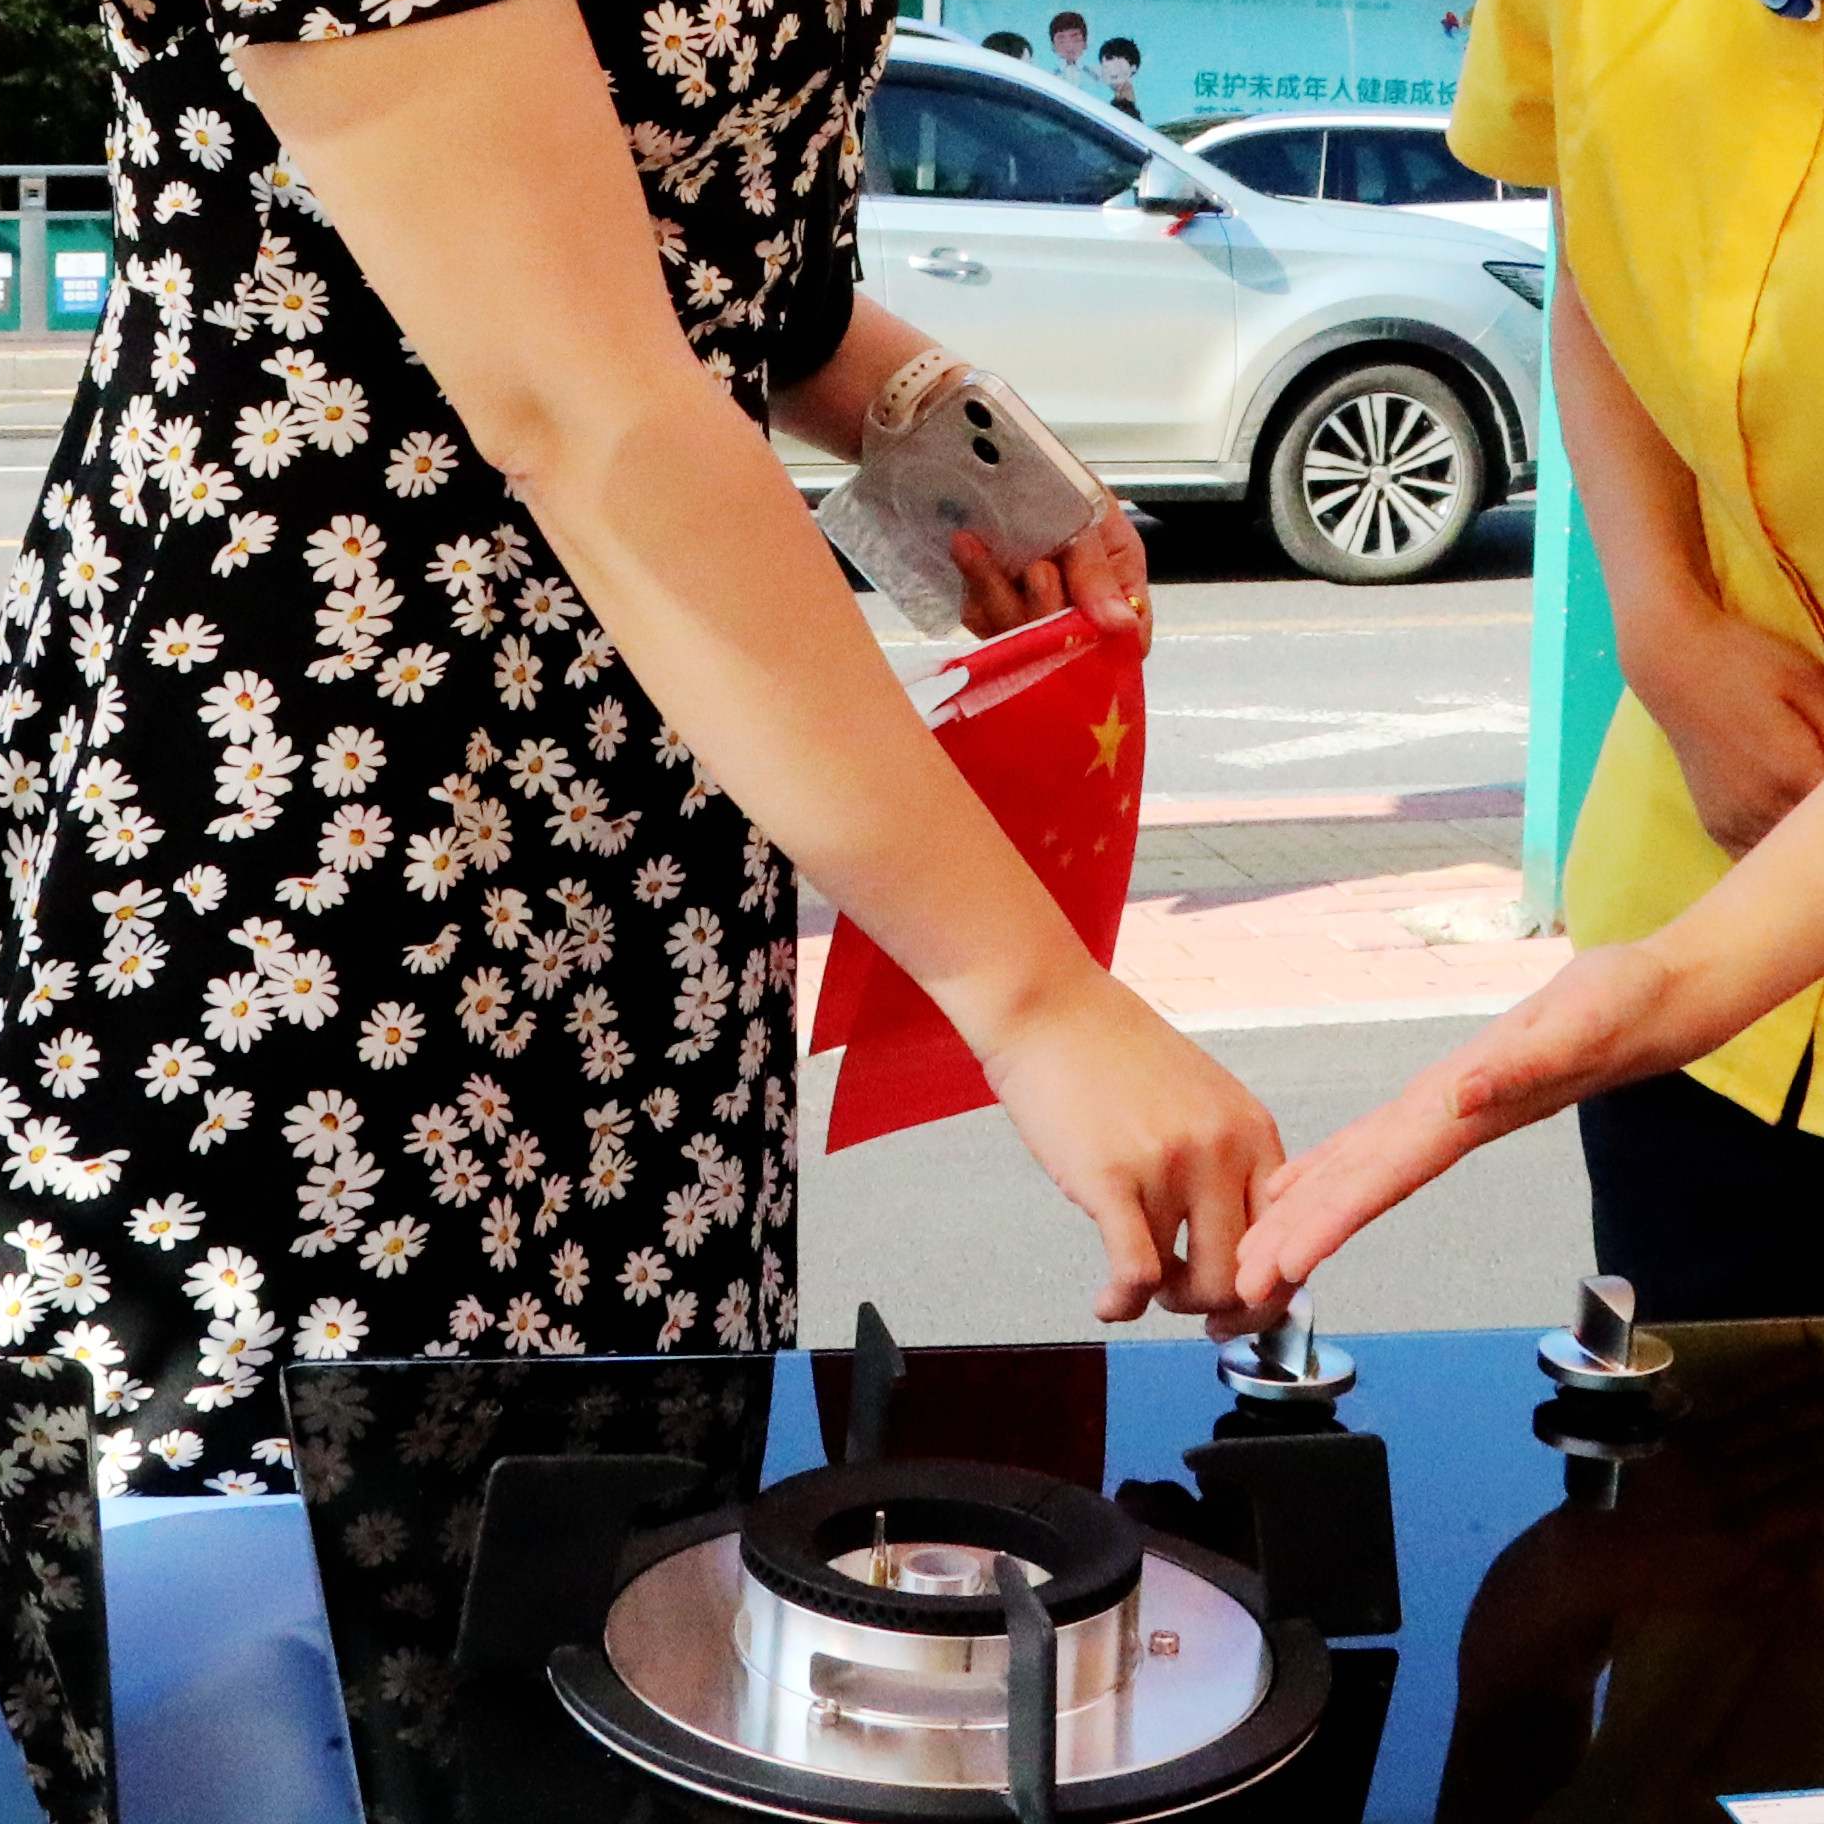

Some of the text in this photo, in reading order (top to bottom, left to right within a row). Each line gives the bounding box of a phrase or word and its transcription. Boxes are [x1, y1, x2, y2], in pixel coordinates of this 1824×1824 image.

[1193, 70, 1457, 107] 保护未成年人健康成长
